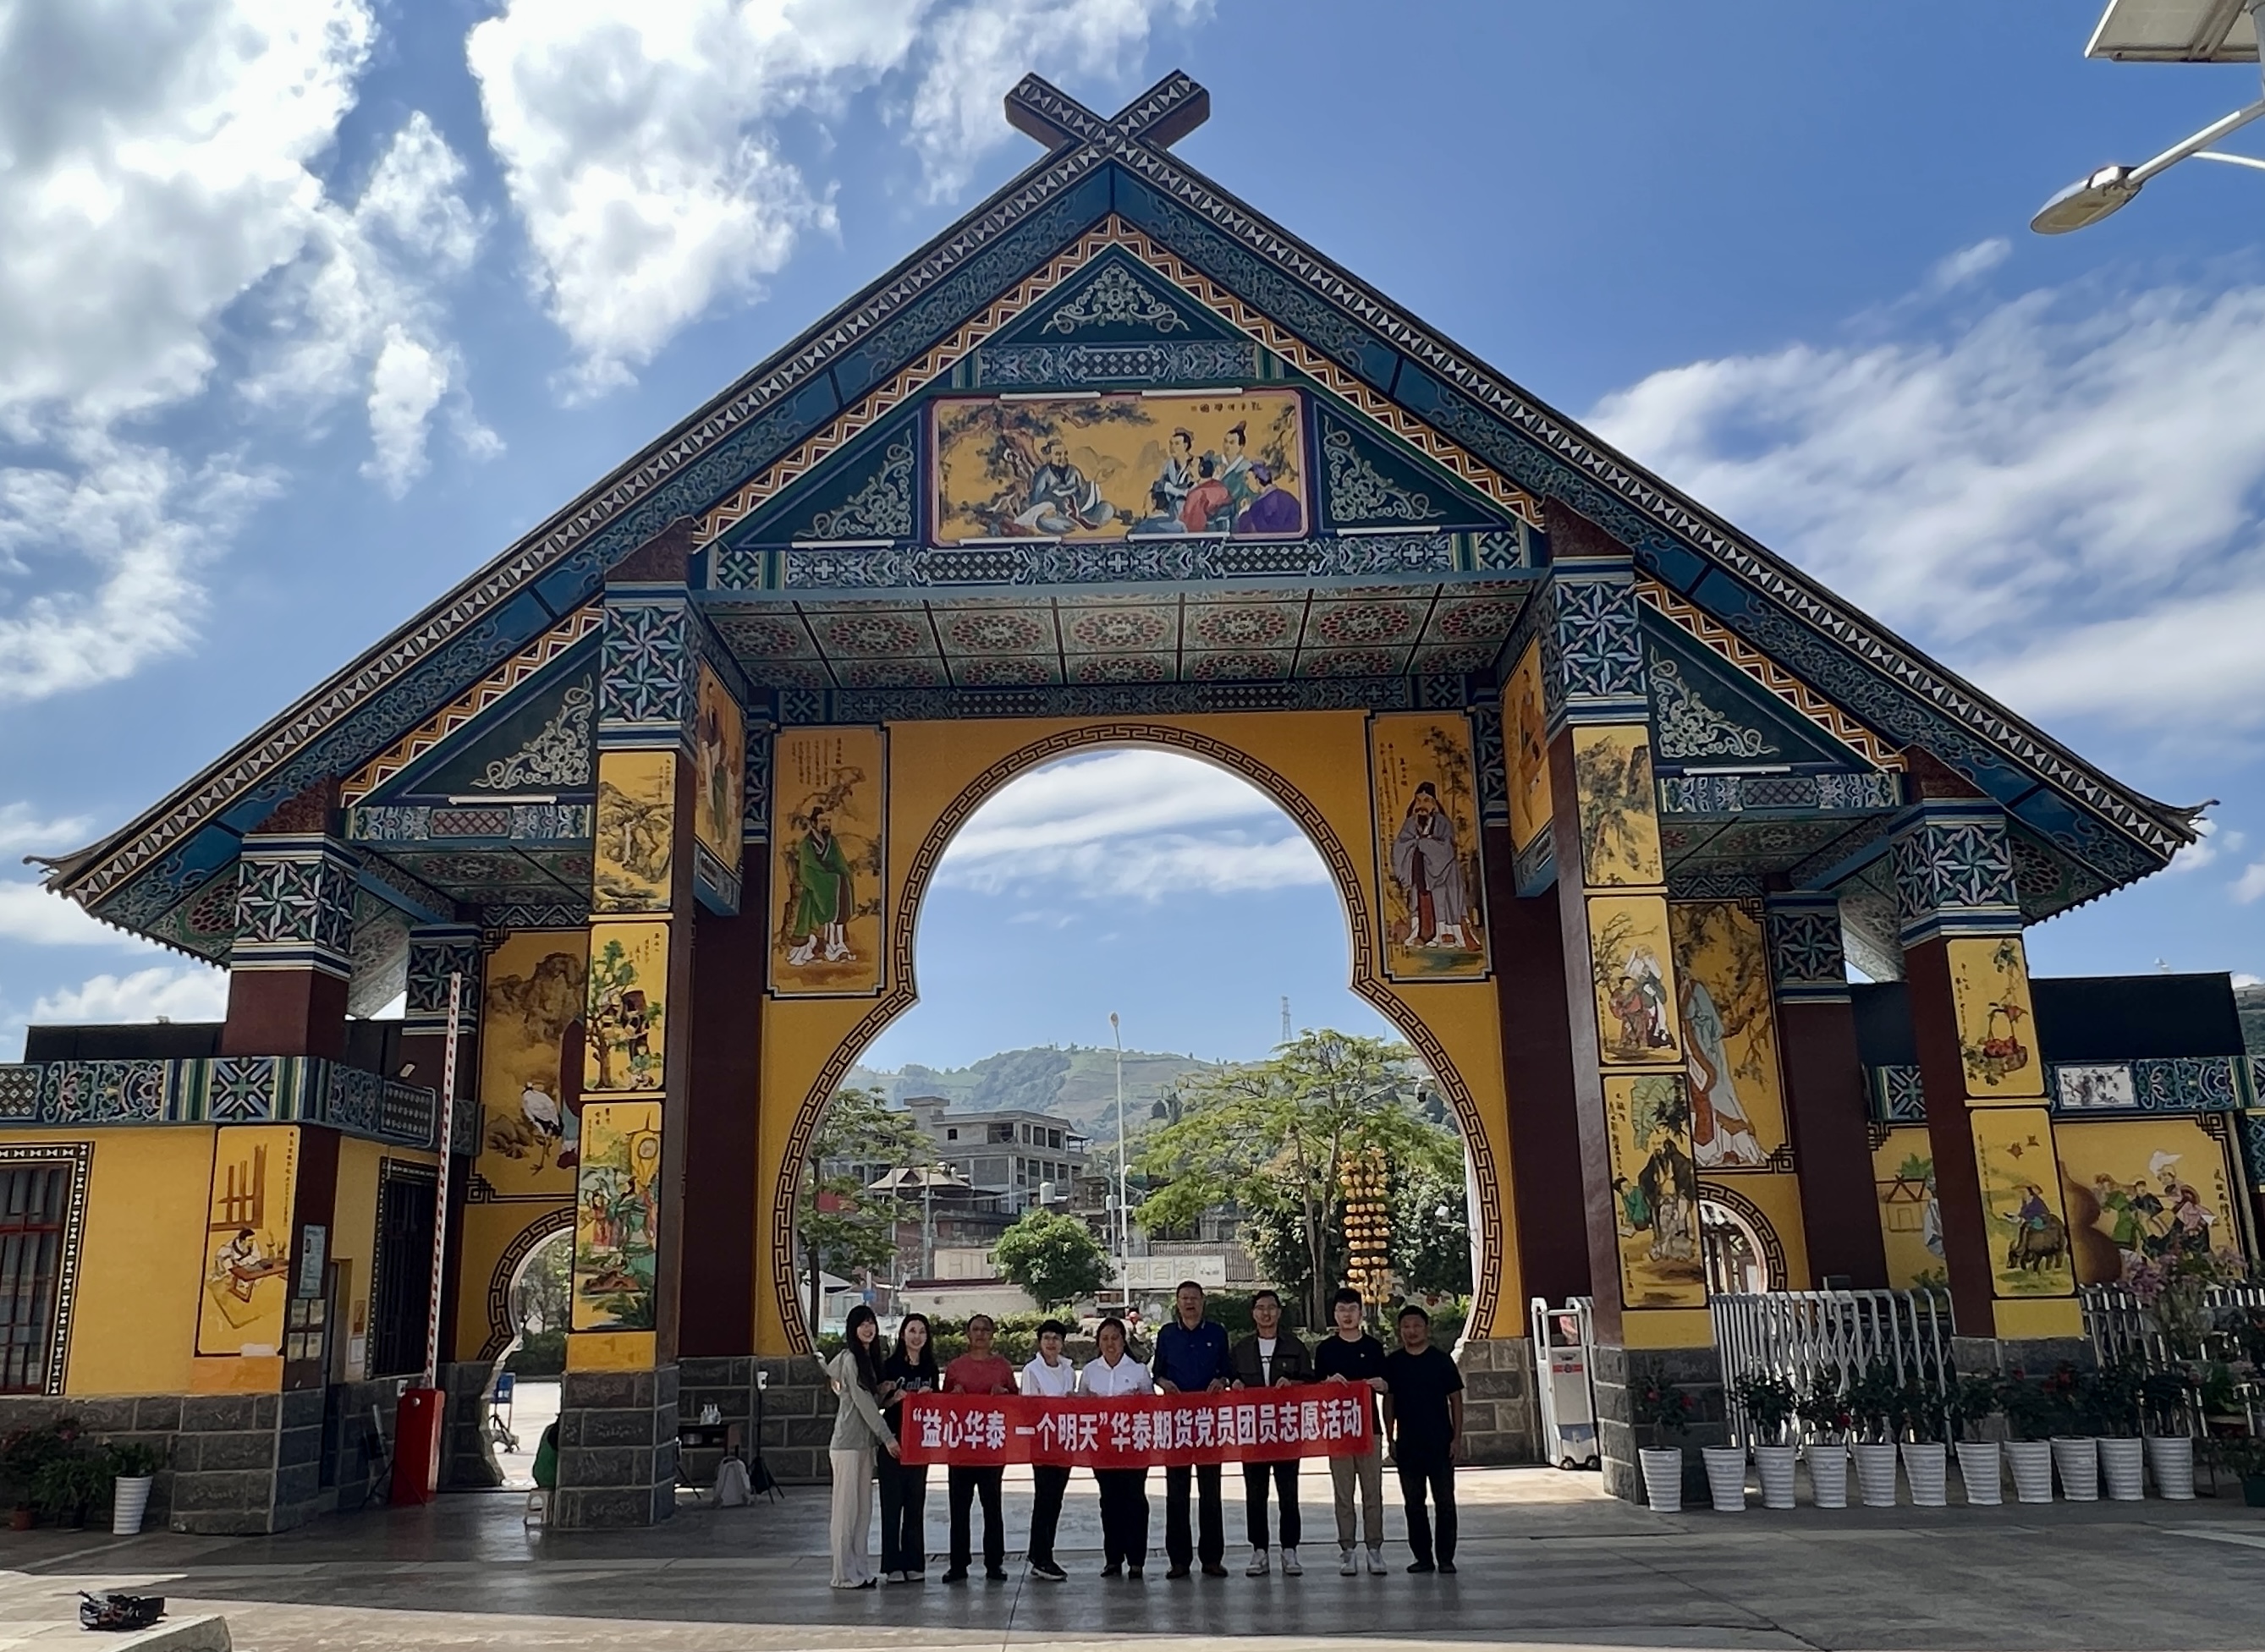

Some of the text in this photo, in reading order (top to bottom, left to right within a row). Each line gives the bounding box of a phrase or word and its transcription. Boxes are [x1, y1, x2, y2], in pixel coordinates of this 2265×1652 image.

[912, 1397, 1362, 1452] “益心华泰 一个明天”华泰期货党员团员志愿活动
